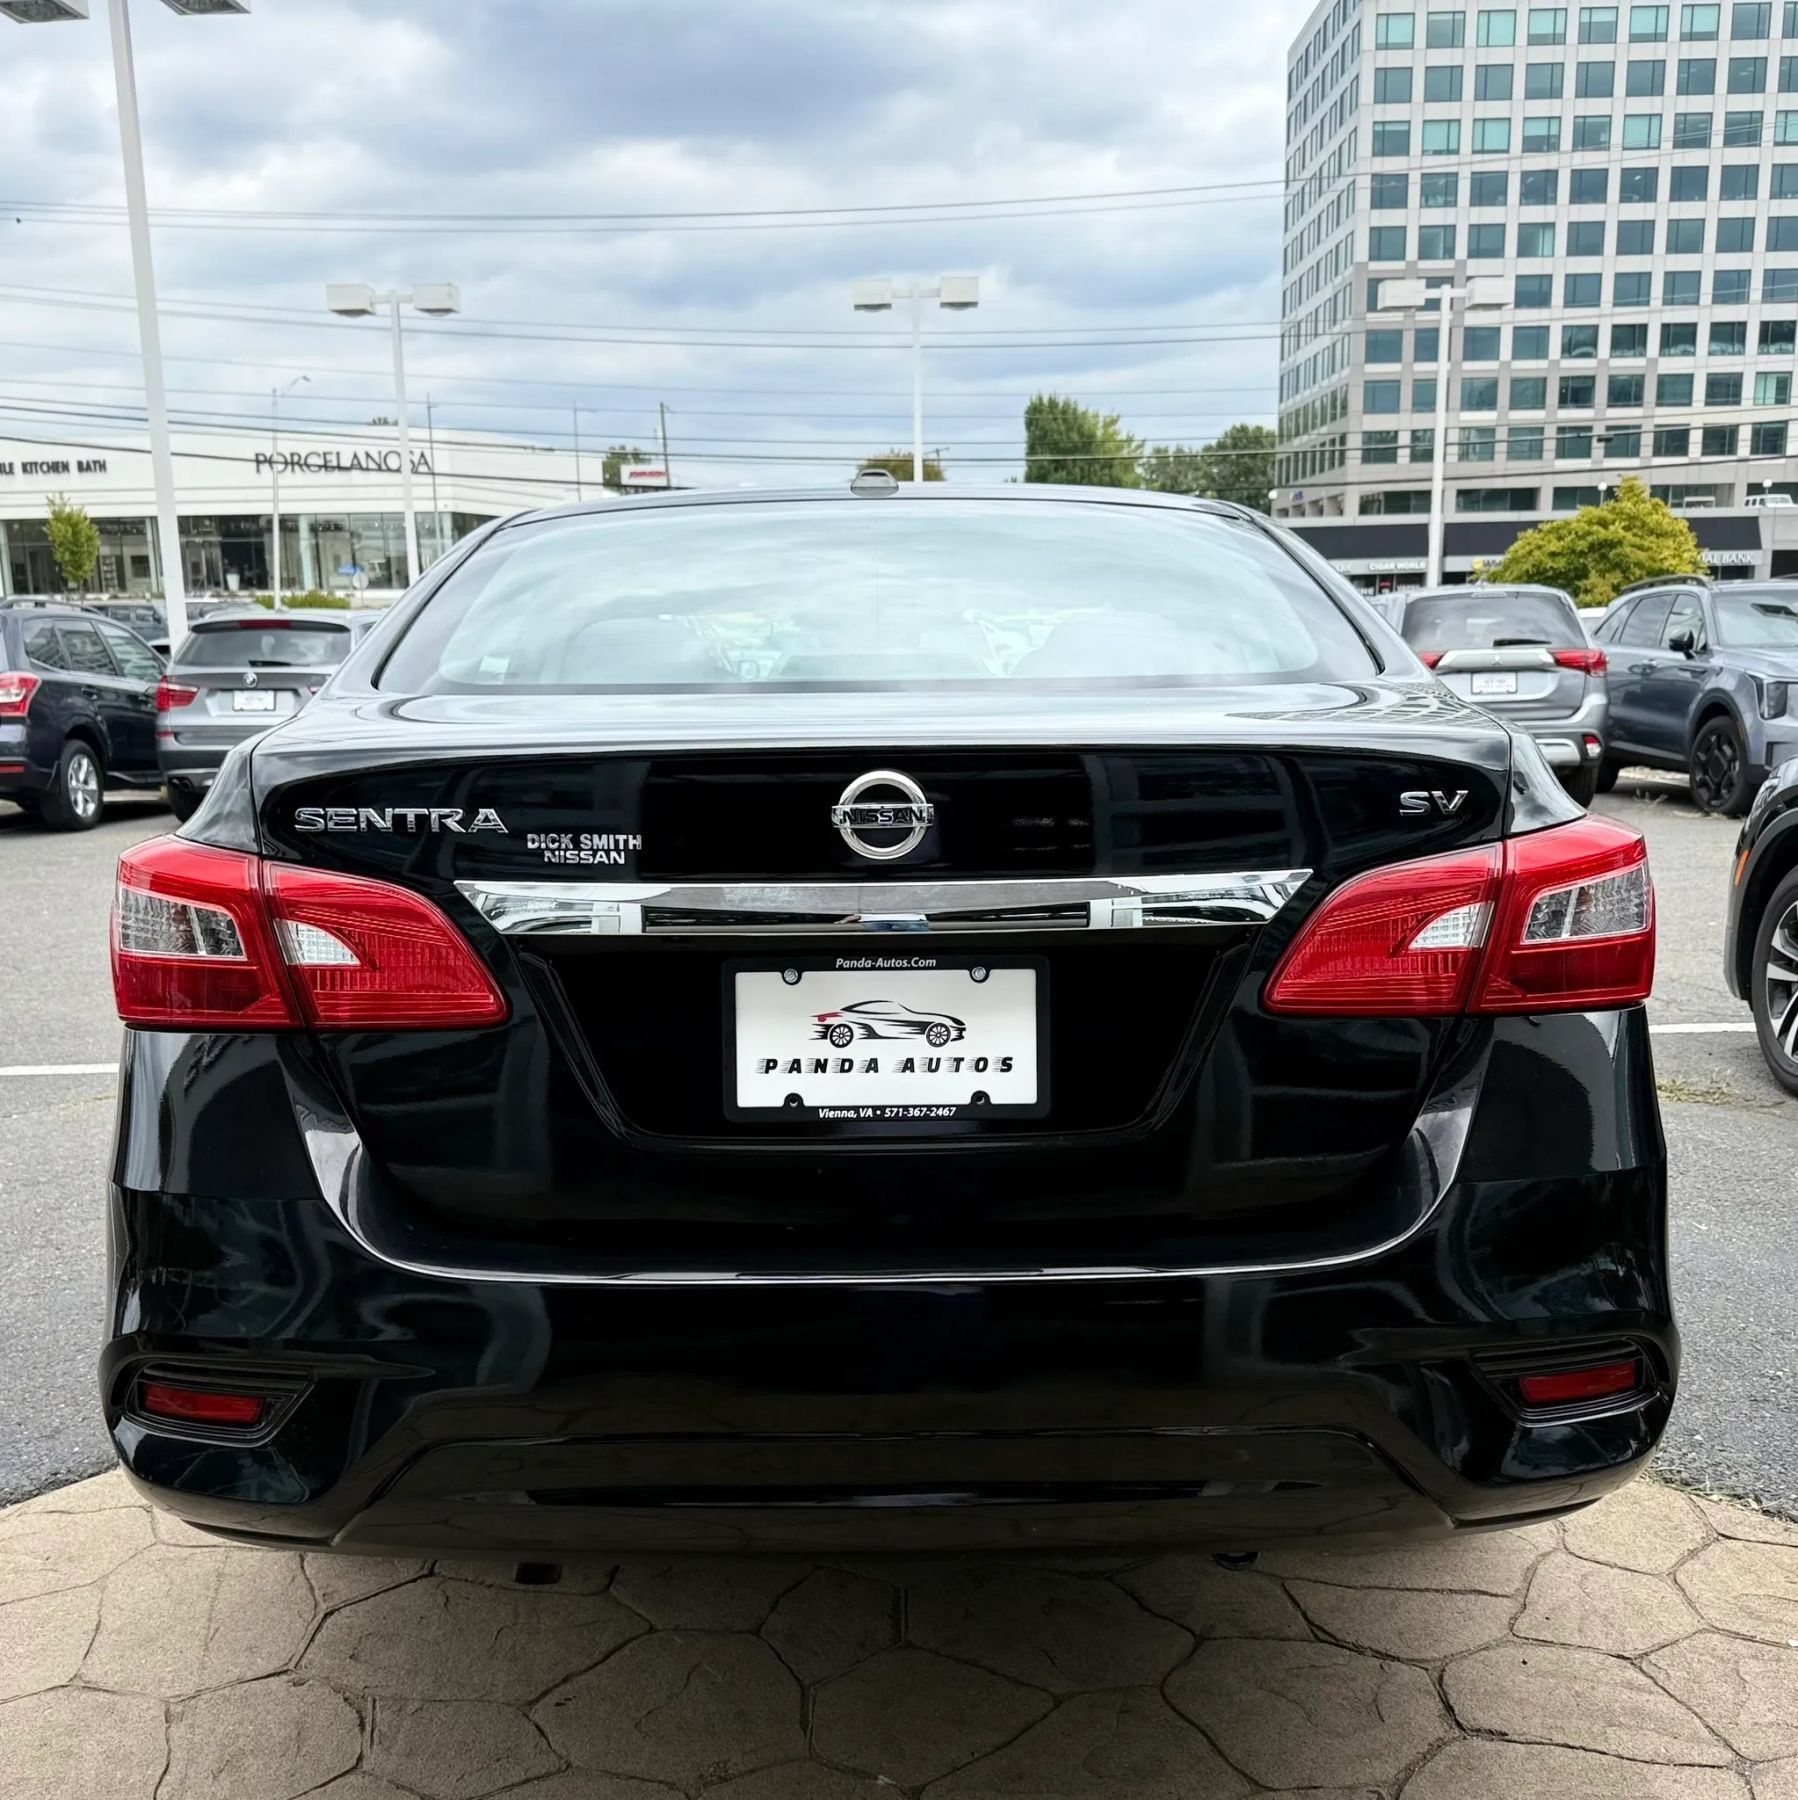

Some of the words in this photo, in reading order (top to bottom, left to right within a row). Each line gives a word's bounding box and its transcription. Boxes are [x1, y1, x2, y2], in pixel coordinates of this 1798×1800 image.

[21, 461, 70, 474] KITCHEN
[77, 459, 107, 473] BATH
[255, 450, 432, 474] PORCELANOSA
[1721, 551, 1754, 563] BANK
[1399, 790, 1469, 816] SV
[294, 807, 509, 833] SENTRA
[841, 808, 925, 824] NISSAN
[527, 833, 574, 849] DICK
[579, 833, 642, 850] SMITH
[544, 850, 625, 865] NISSAN
[835, 957, 937, 968] Panda-Autos.Com
[757, 1058, 879, 1074] PANDA
[892, 1057, 1013, 1073] AUTOS
[818, 1108, 857, 1119] Vienna,
[859, 1108, 873, 1118] VA
[884, 1107, 957, 1117] 571-367-2467
